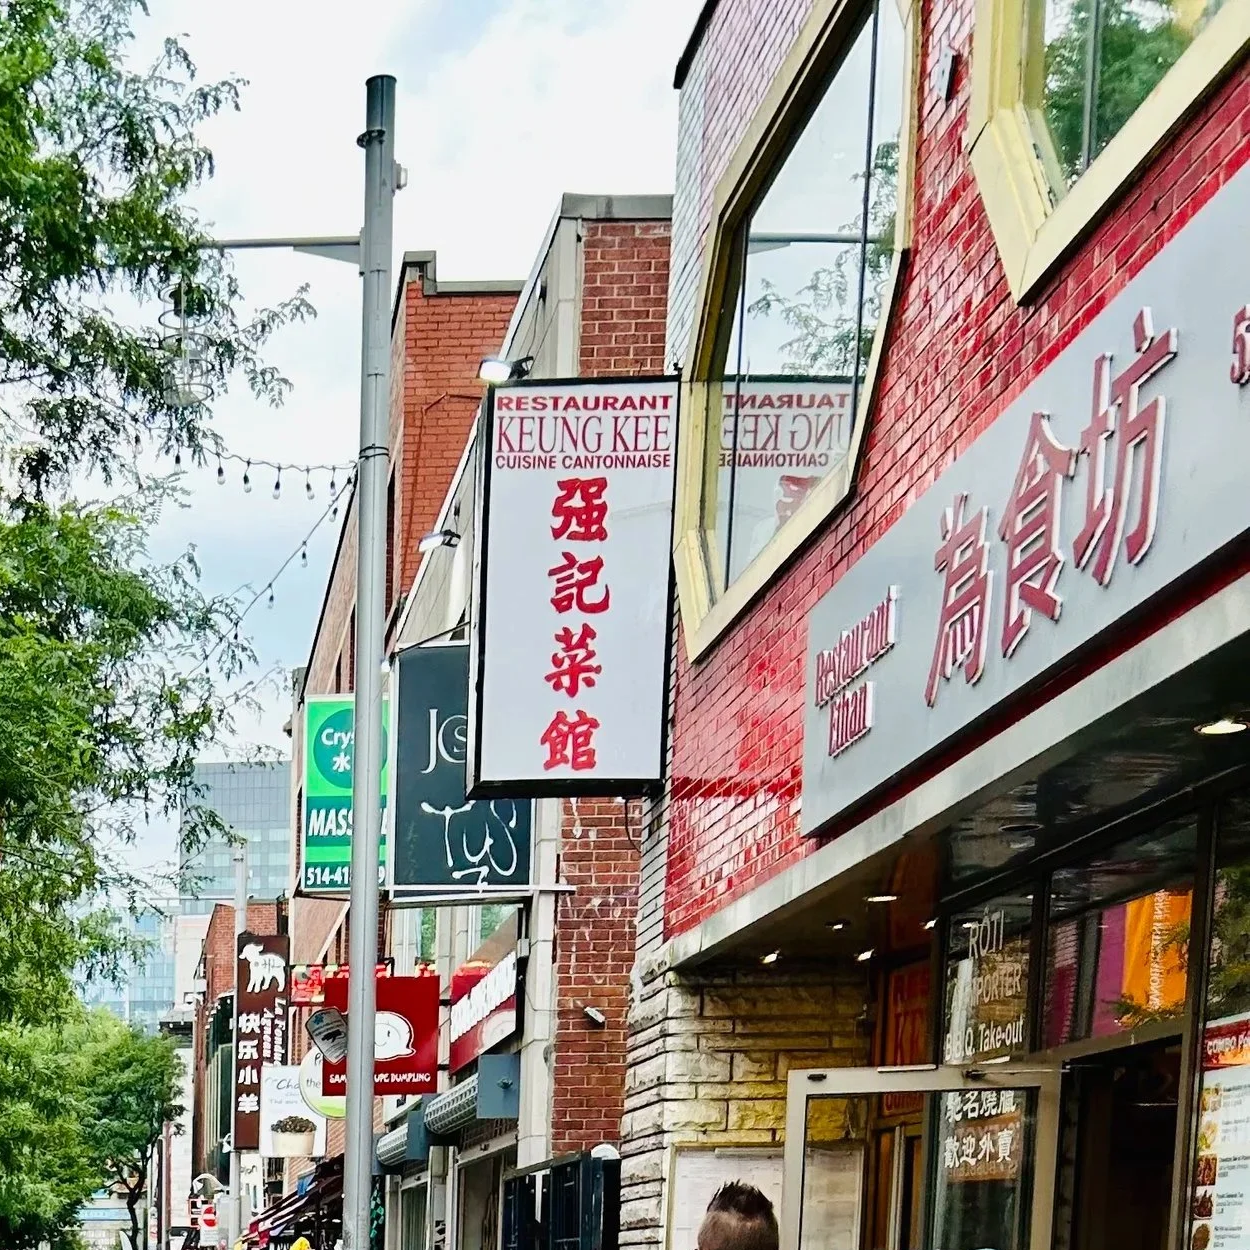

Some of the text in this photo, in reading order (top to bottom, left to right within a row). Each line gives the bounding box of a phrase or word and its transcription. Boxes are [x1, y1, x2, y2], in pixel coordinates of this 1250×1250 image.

[497, 395, 673, 411] RESTAURANT
[496, 415, 671, 454] KEUNG KEE
[495, 454, 671, 470] CUISINE CANTONNAISE
[815, 584, 898, 708] Restaurant
[829, 681, 875, 758] Ethan
[237, 1013, 262, 1114] 快乐小羊
[390, 1072, 431, 1083] DUMPLING
